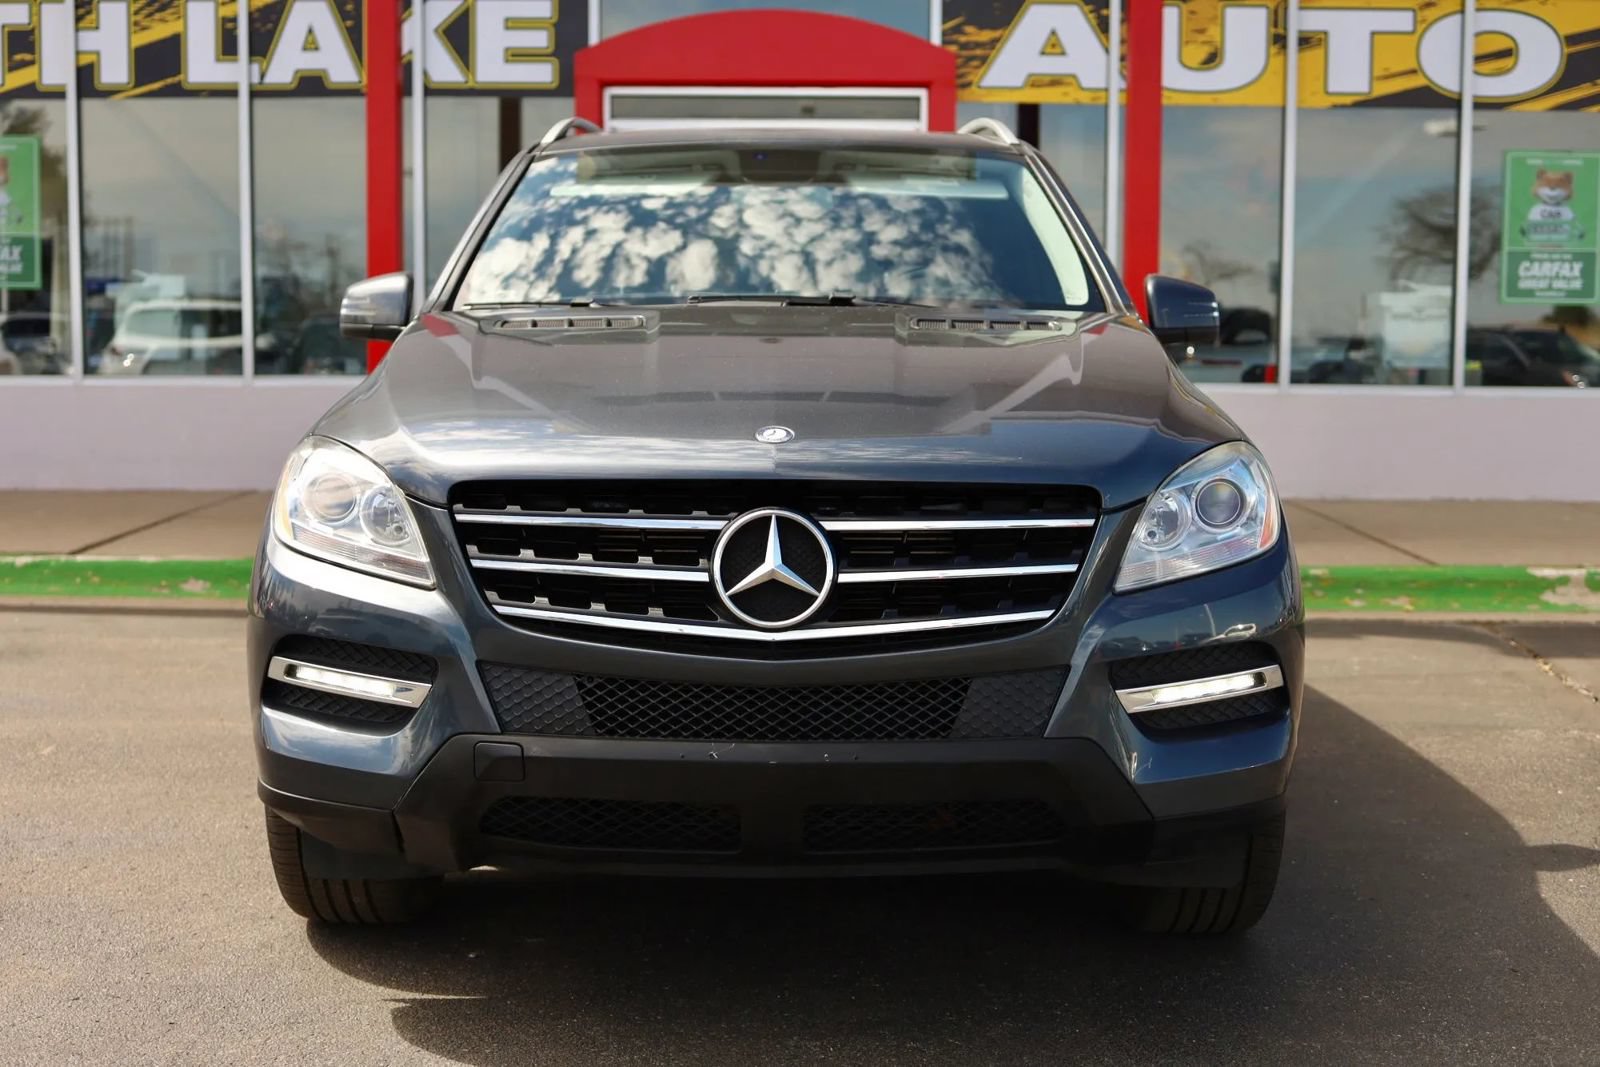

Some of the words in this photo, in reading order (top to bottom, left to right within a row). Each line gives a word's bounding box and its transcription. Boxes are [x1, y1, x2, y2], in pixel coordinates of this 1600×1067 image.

[184, 0, 555, 84] LAKE
[977, 3, 1564, 98] AUTO
[1518, 261, 1584, 277] CARFAX
